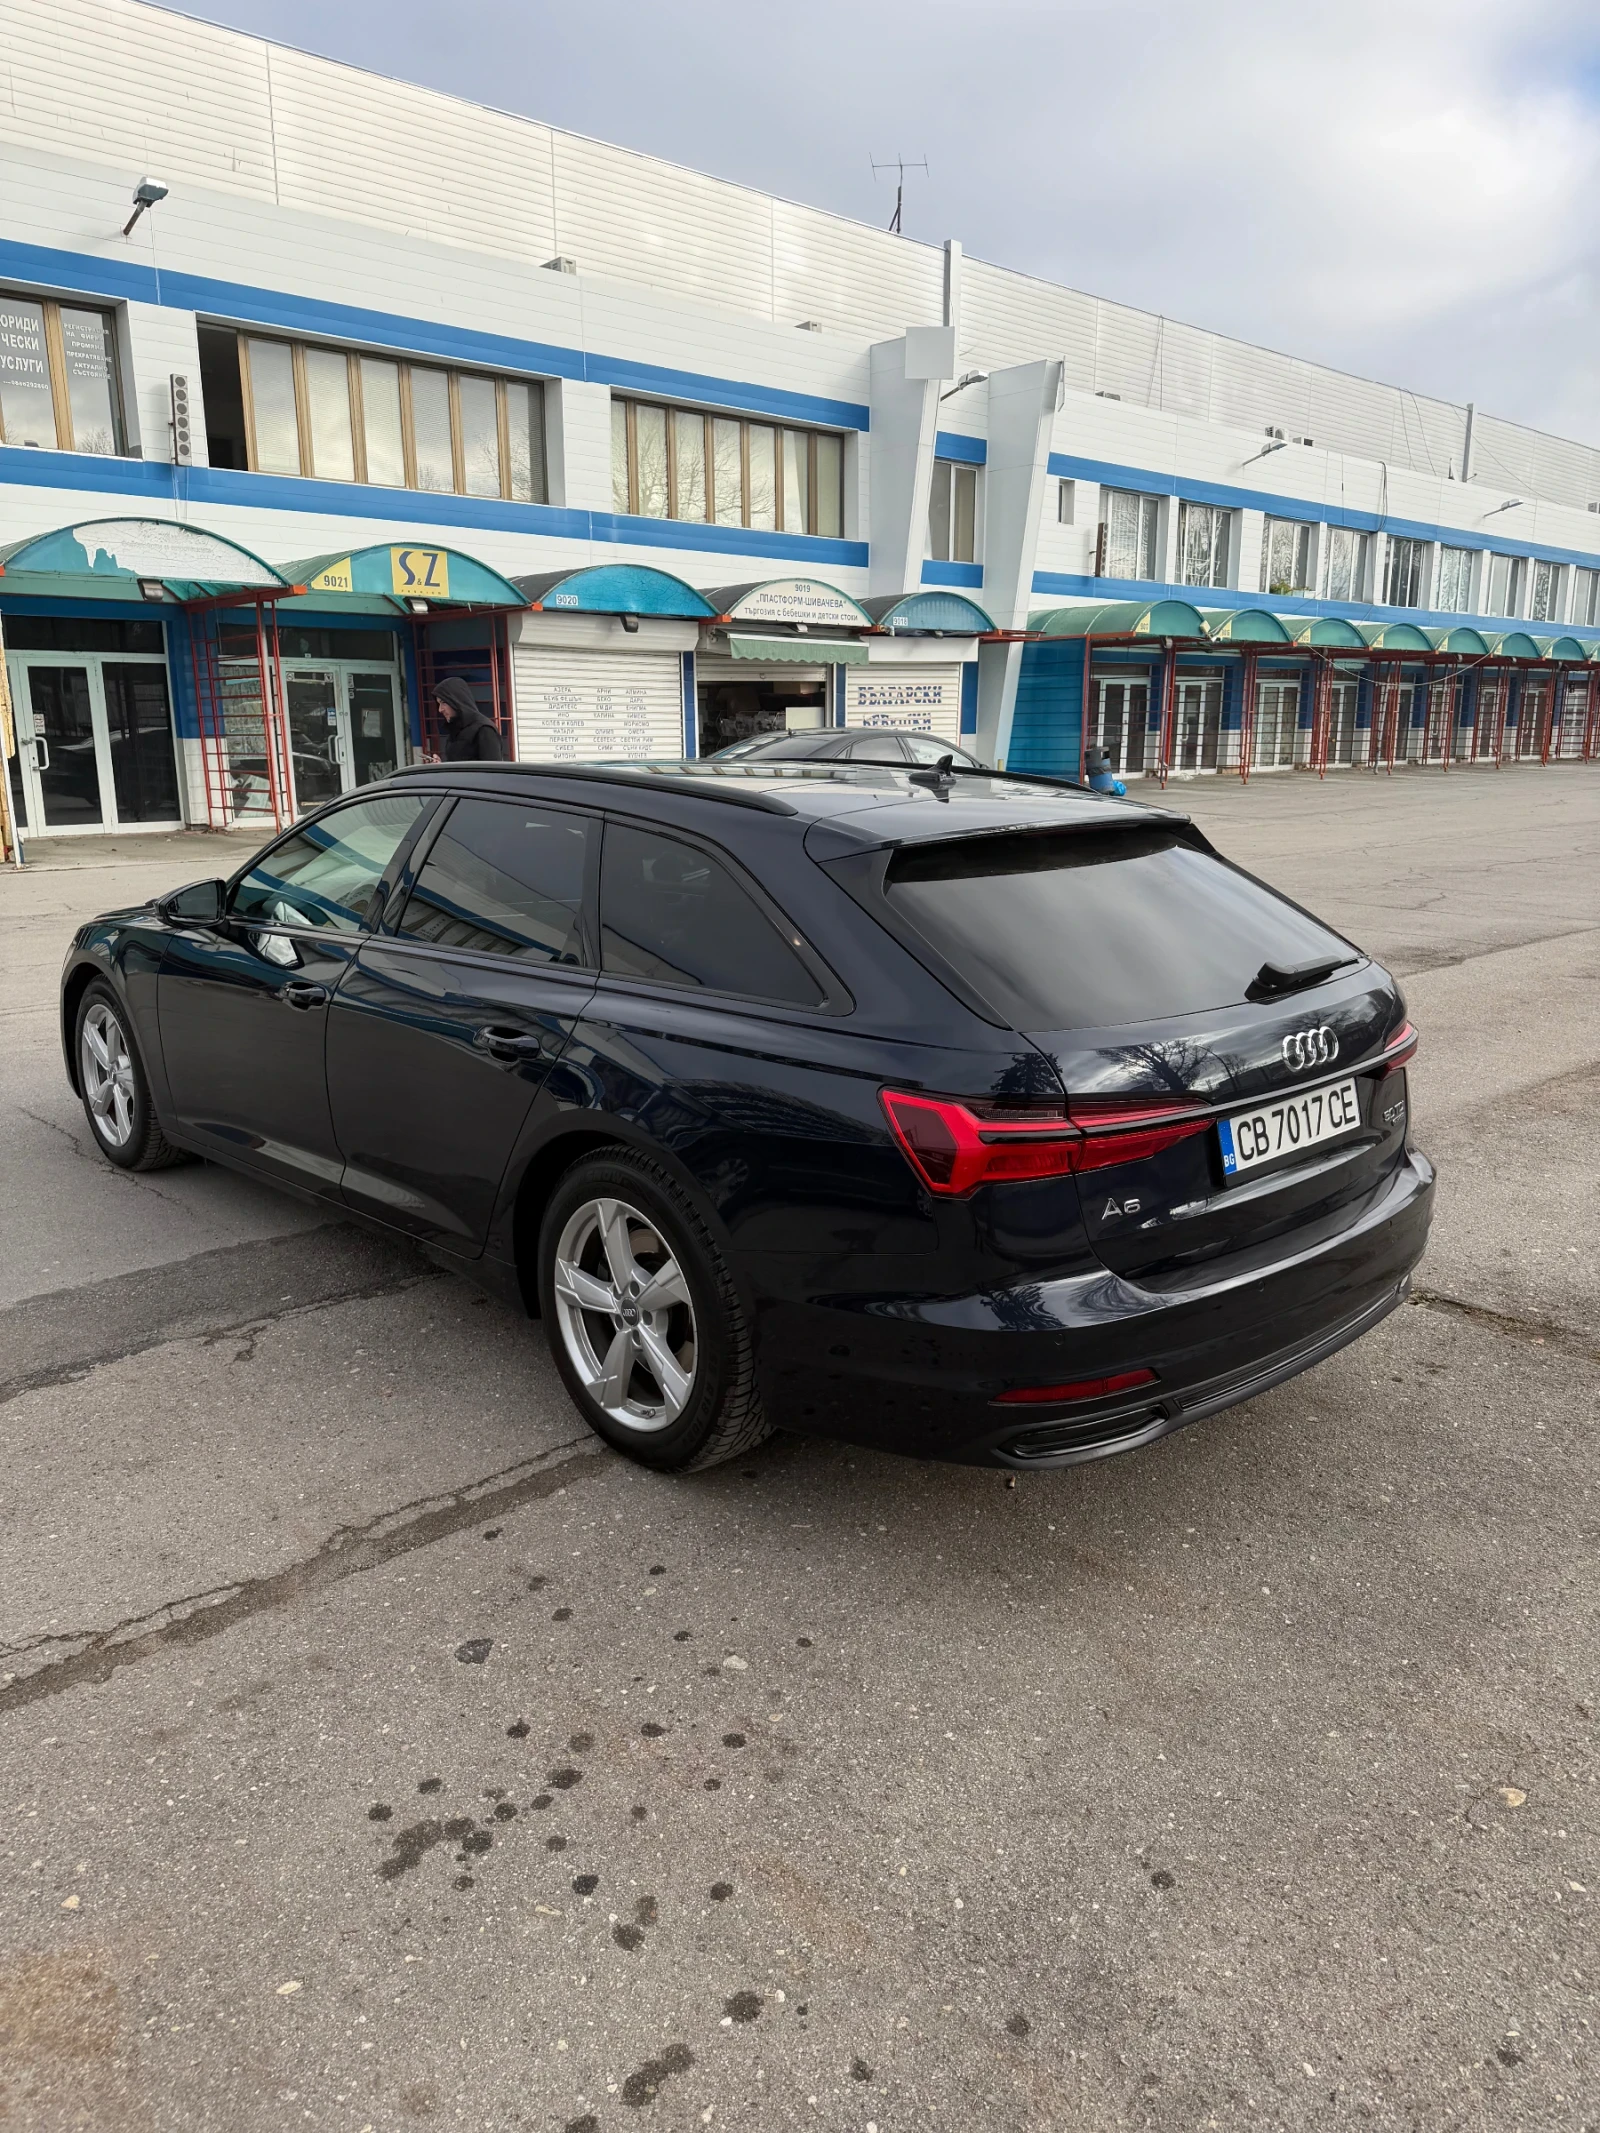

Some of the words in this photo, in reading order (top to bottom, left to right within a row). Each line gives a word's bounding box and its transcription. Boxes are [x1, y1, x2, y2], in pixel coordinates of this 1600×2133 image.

[0, 332, 40, 350] ЧЕСКИ
[71, 340, 104, 350] ПРОМЯНА
[66, 350, 112, 362] ПРЕКРАТЯВАНЕ
[0, 354, 44, 374] УСЛУГИ
[74, 362, 108, 372] АКТУАЛНО
[72, 368, 112, 380] СЪСТОЯНИЕ
[324, 574, 348, 588] 9021
[794, 584, 810, 592] 9019
[557, 595, 578, 604] 9020
[818, 612, 839, 620] детски
[1237, 1116, 1270, 1161] CB
[1272, 1094, 1323, 1150] 7017
[1328, 1084, 1356, 1128] CE
[1224, 1153, 1235, 1167] BG
[1102, 1197, 1141, 1220] A6
